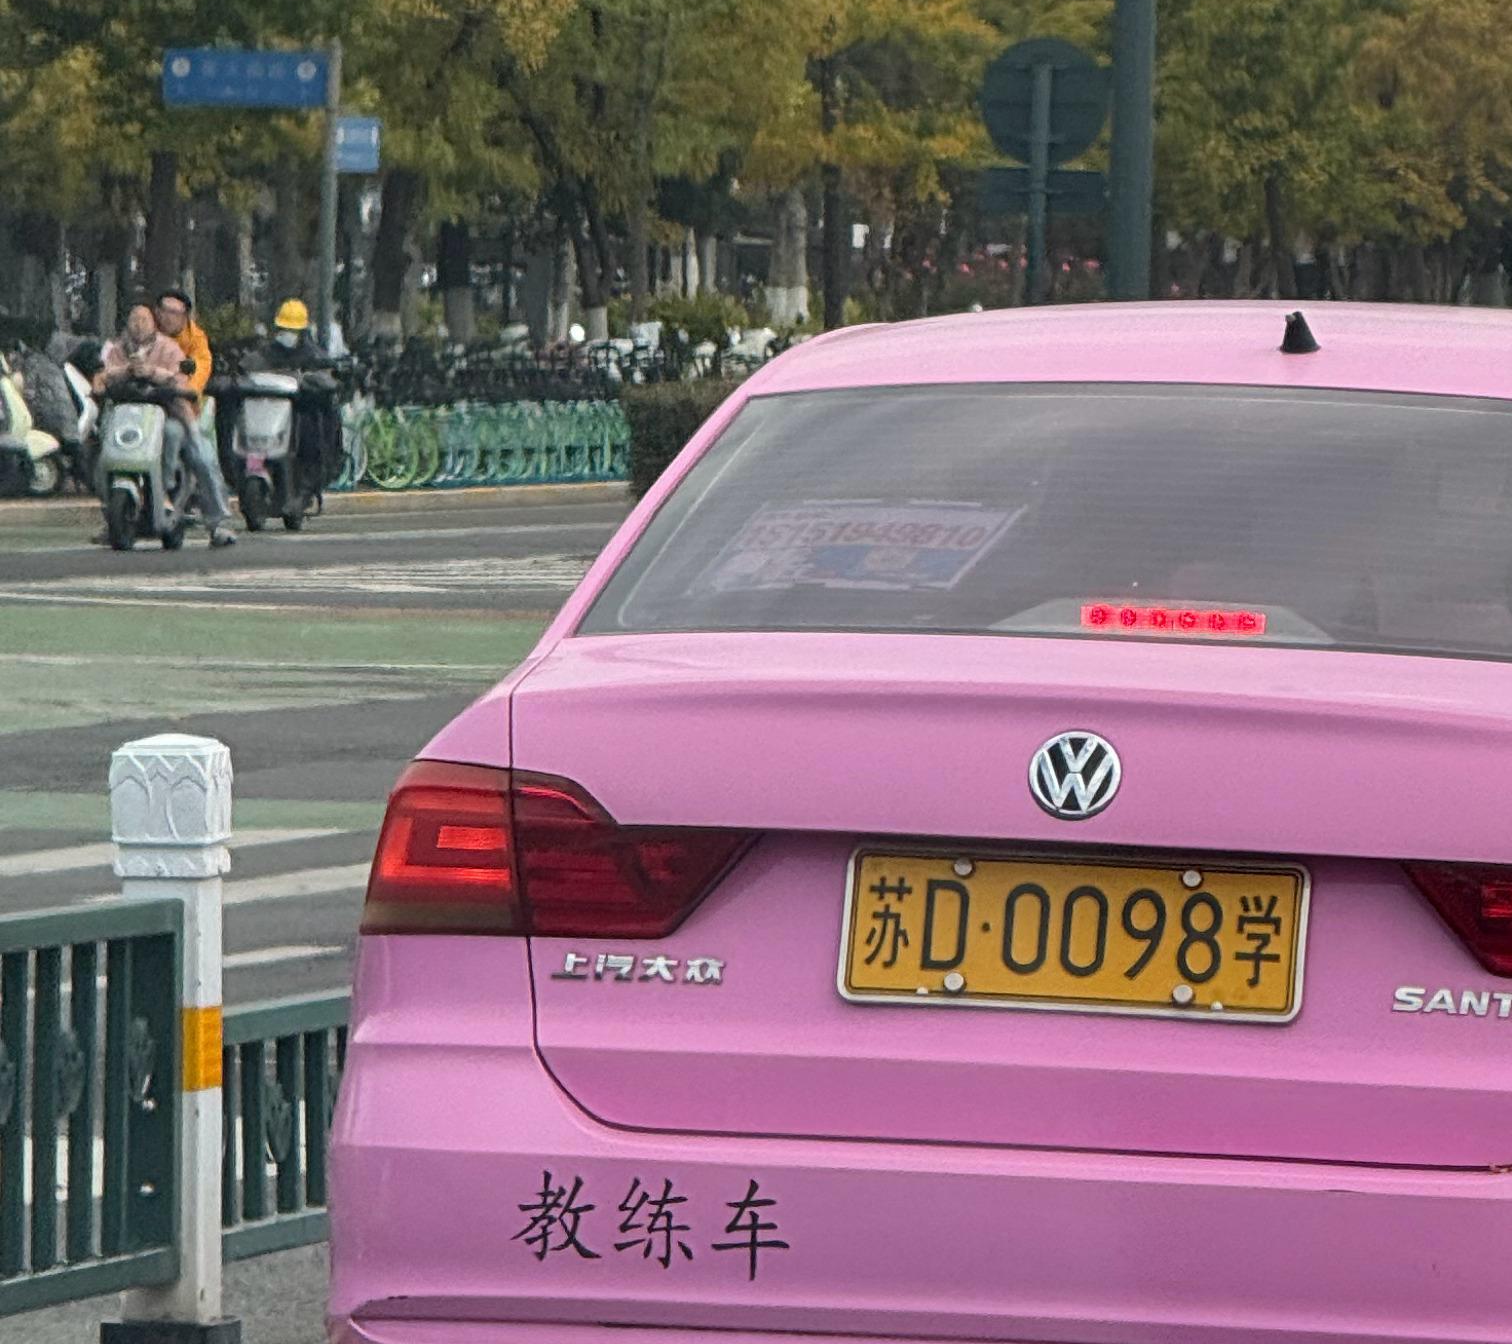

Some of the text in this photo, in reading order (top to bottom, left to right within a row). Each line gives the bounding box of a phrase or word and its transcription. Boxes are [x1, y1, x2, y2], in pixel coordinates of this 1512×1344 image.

[1033, 733, 1117, 815] VW
[551, 952, 726, 984] 上汽大众
[863, 875, 1282, 988] 苏D·0098学
[509, 1169, 791, 1282] 教练车
